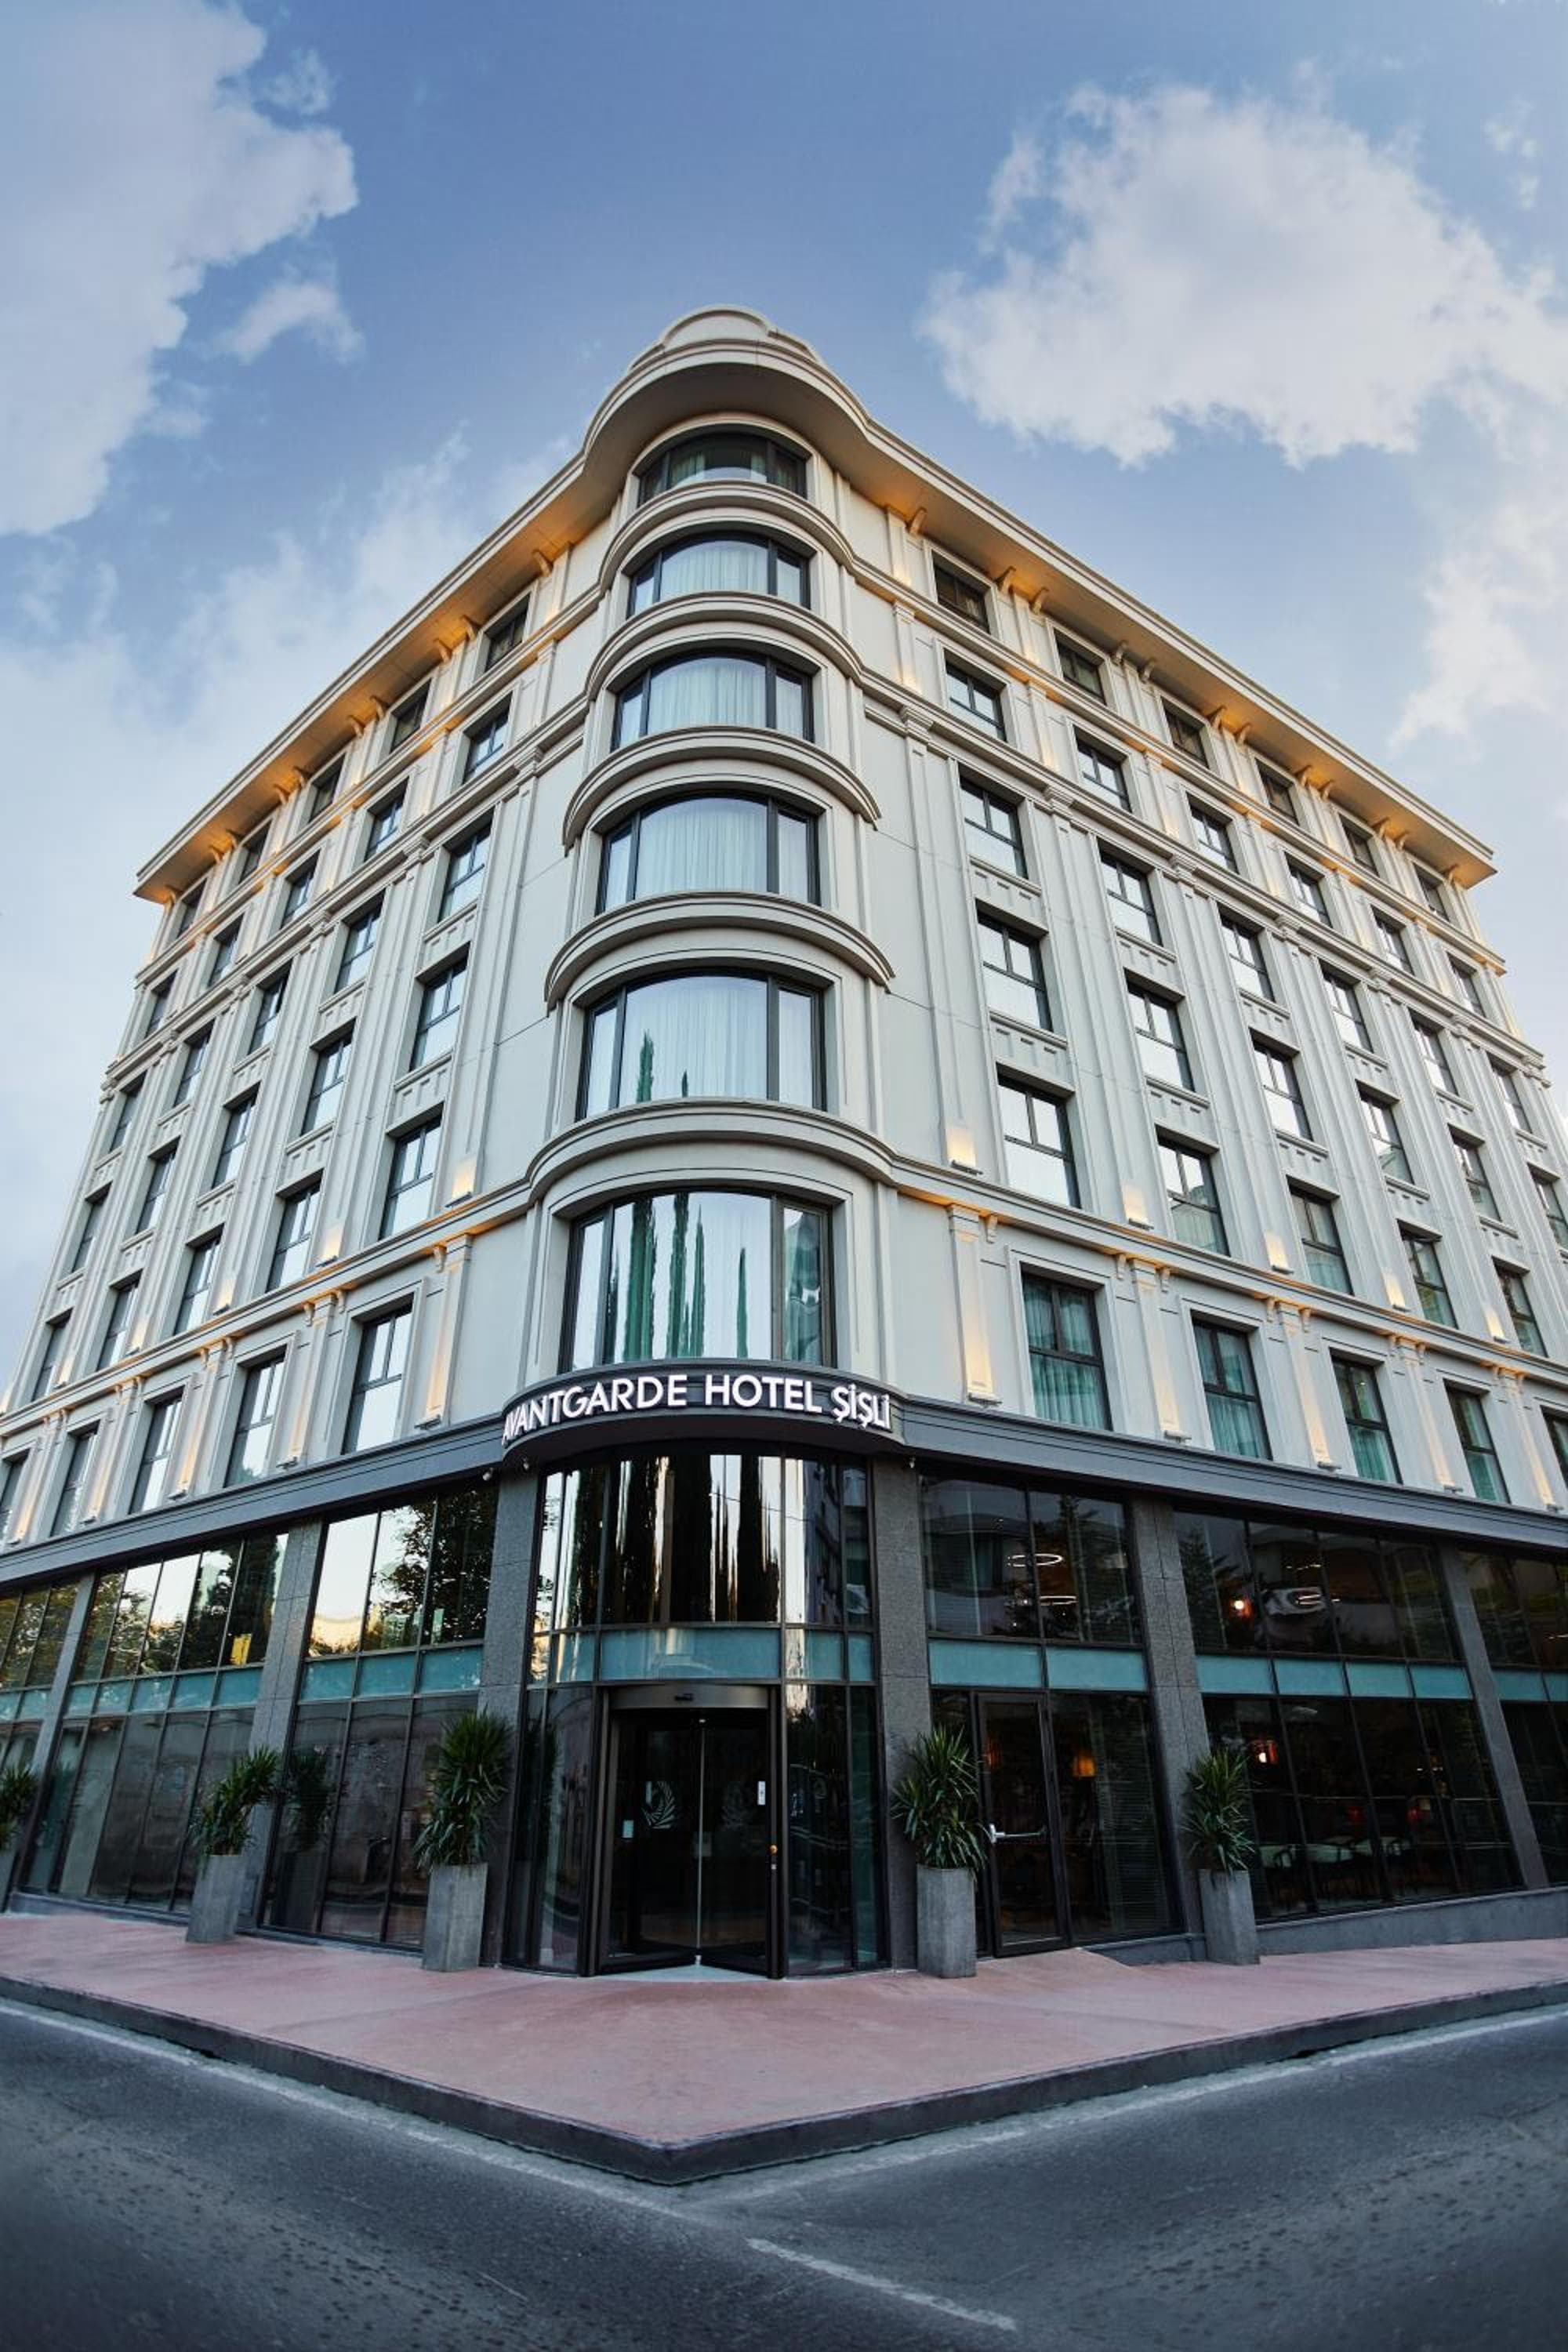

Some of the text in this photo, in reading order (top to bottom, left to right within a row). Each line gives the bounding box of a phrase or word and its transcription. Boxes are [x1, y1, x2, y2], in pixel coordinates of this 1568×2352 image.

[501, 1374, 891, 1446] AVANTGARDE HOTEL ŞİŞLİ
